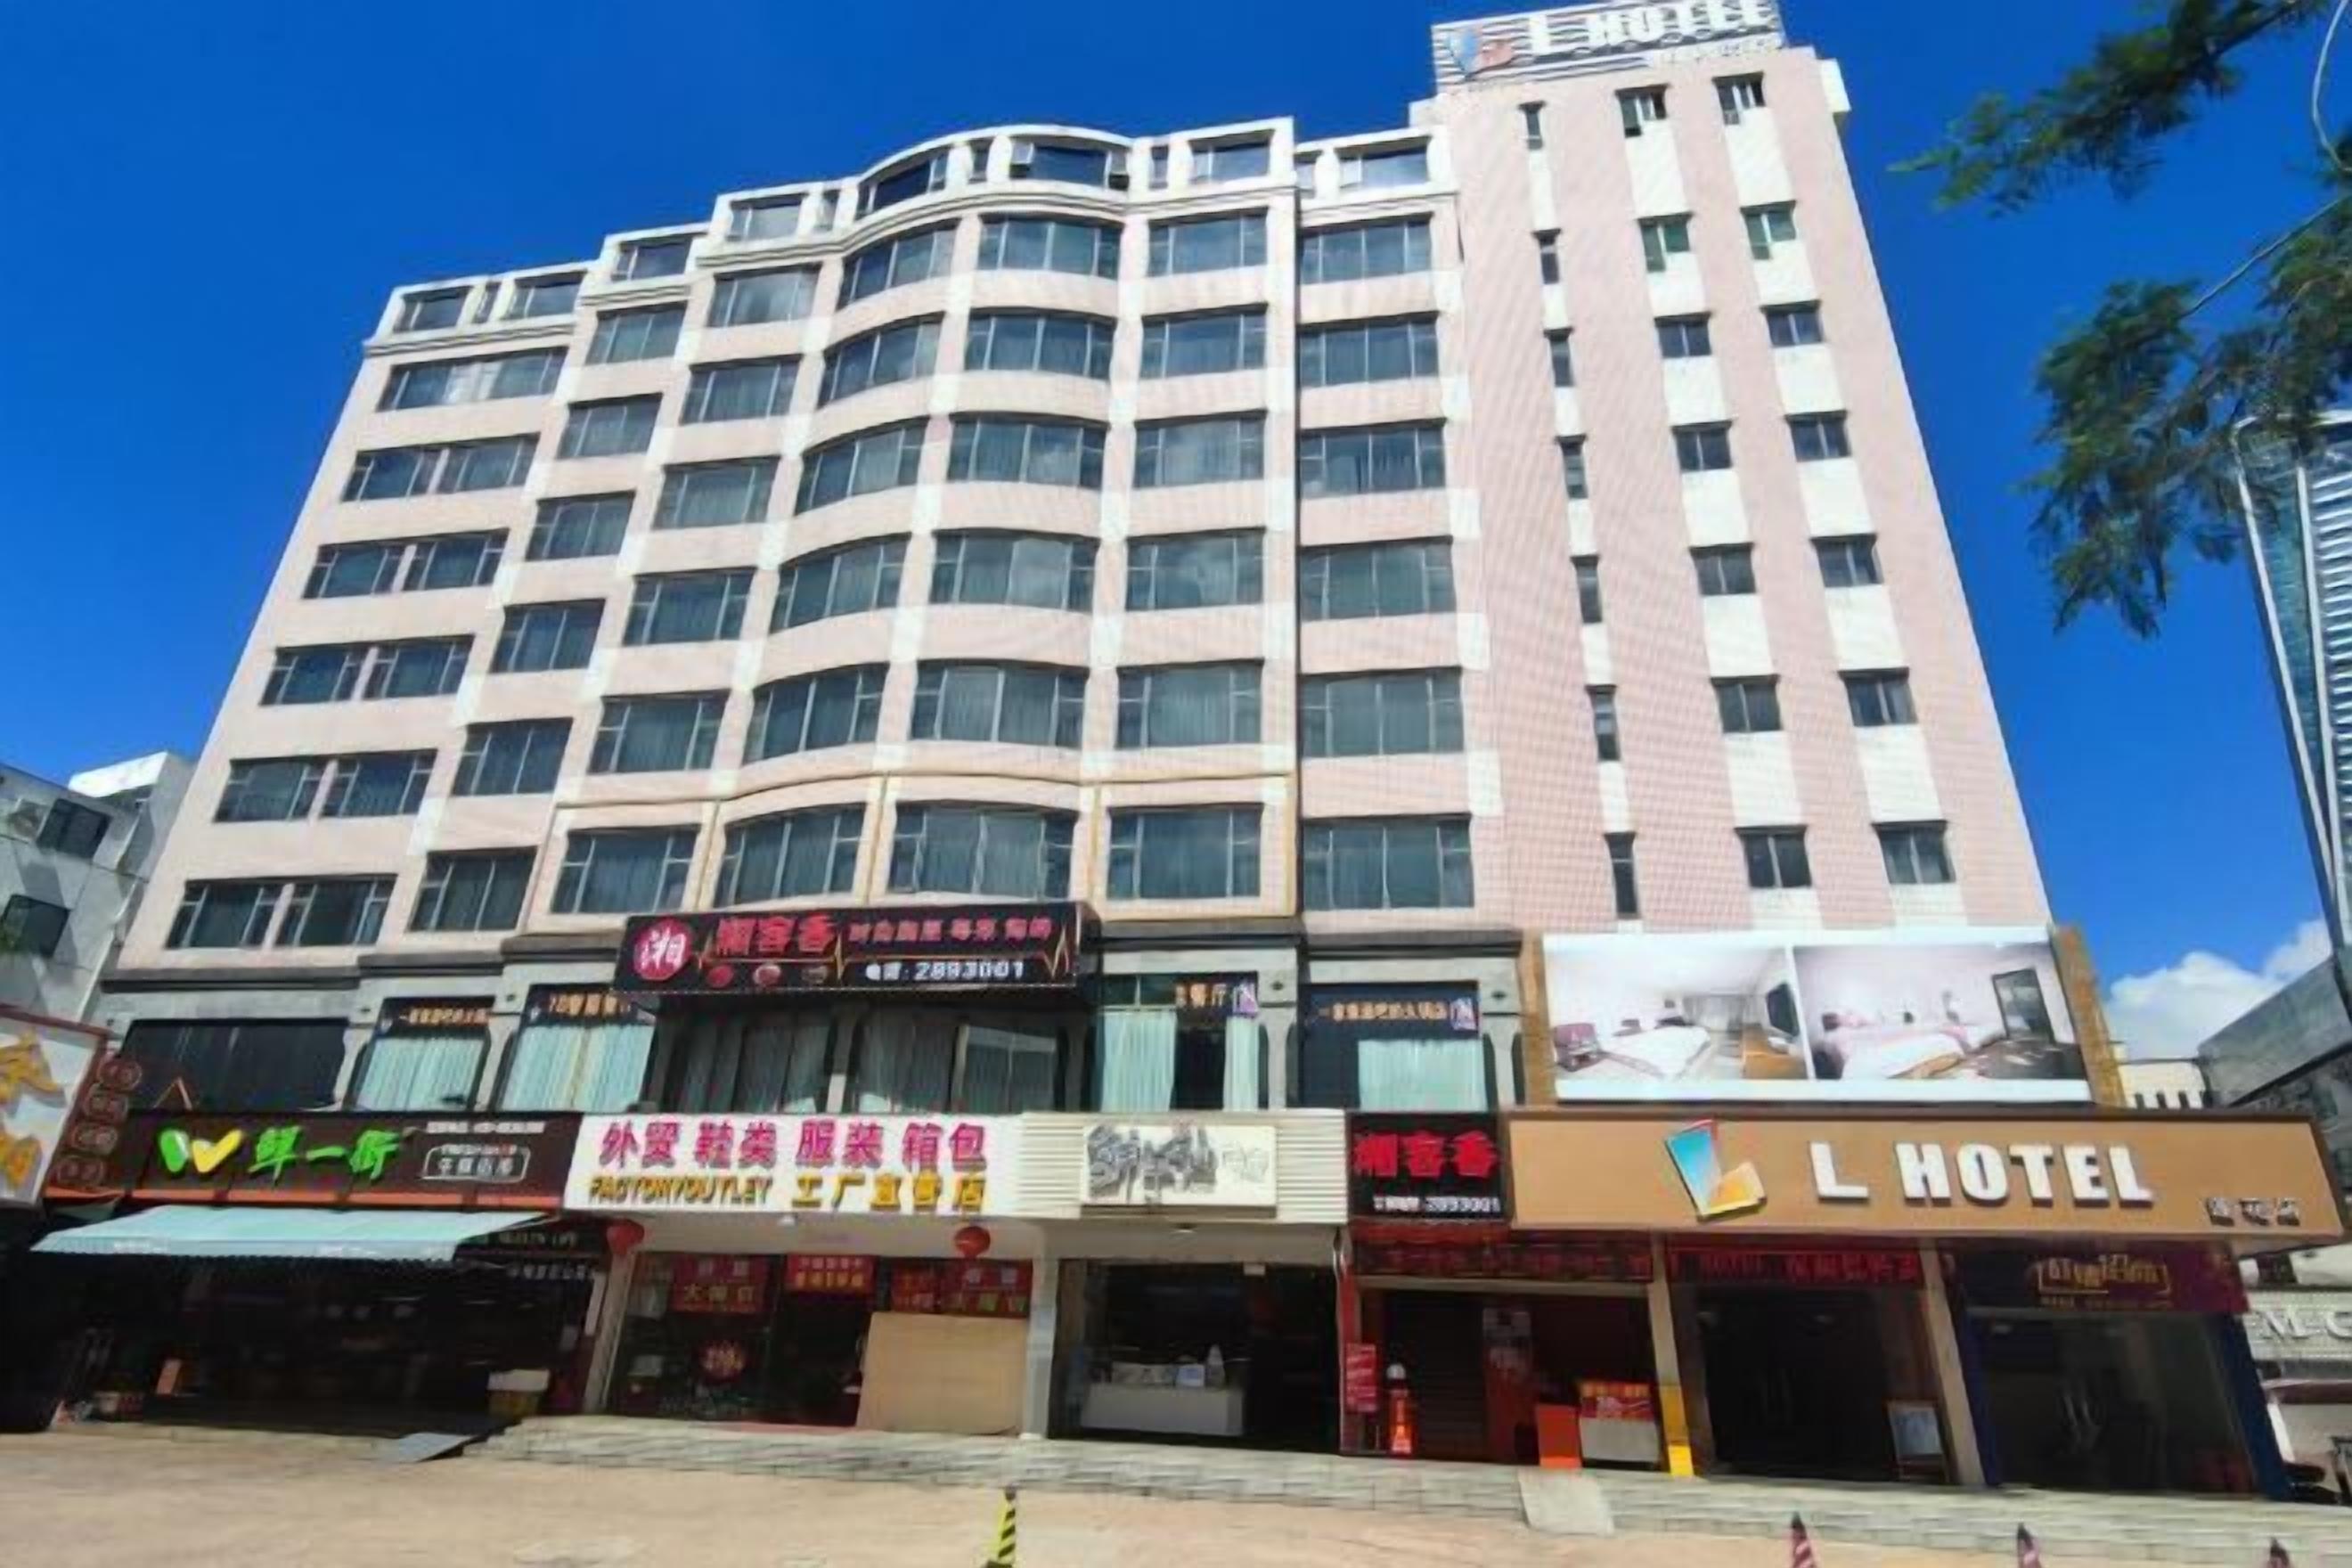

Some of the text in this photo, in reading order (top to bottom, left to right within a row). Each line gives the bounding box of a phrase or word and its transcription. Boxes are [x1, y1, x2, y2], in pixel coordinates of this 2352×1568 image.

[599, 1118, 988, 1172] 外贸 鞋类 服装 箱包
[1809, 1141, 2154, 1209] L HOTEL
